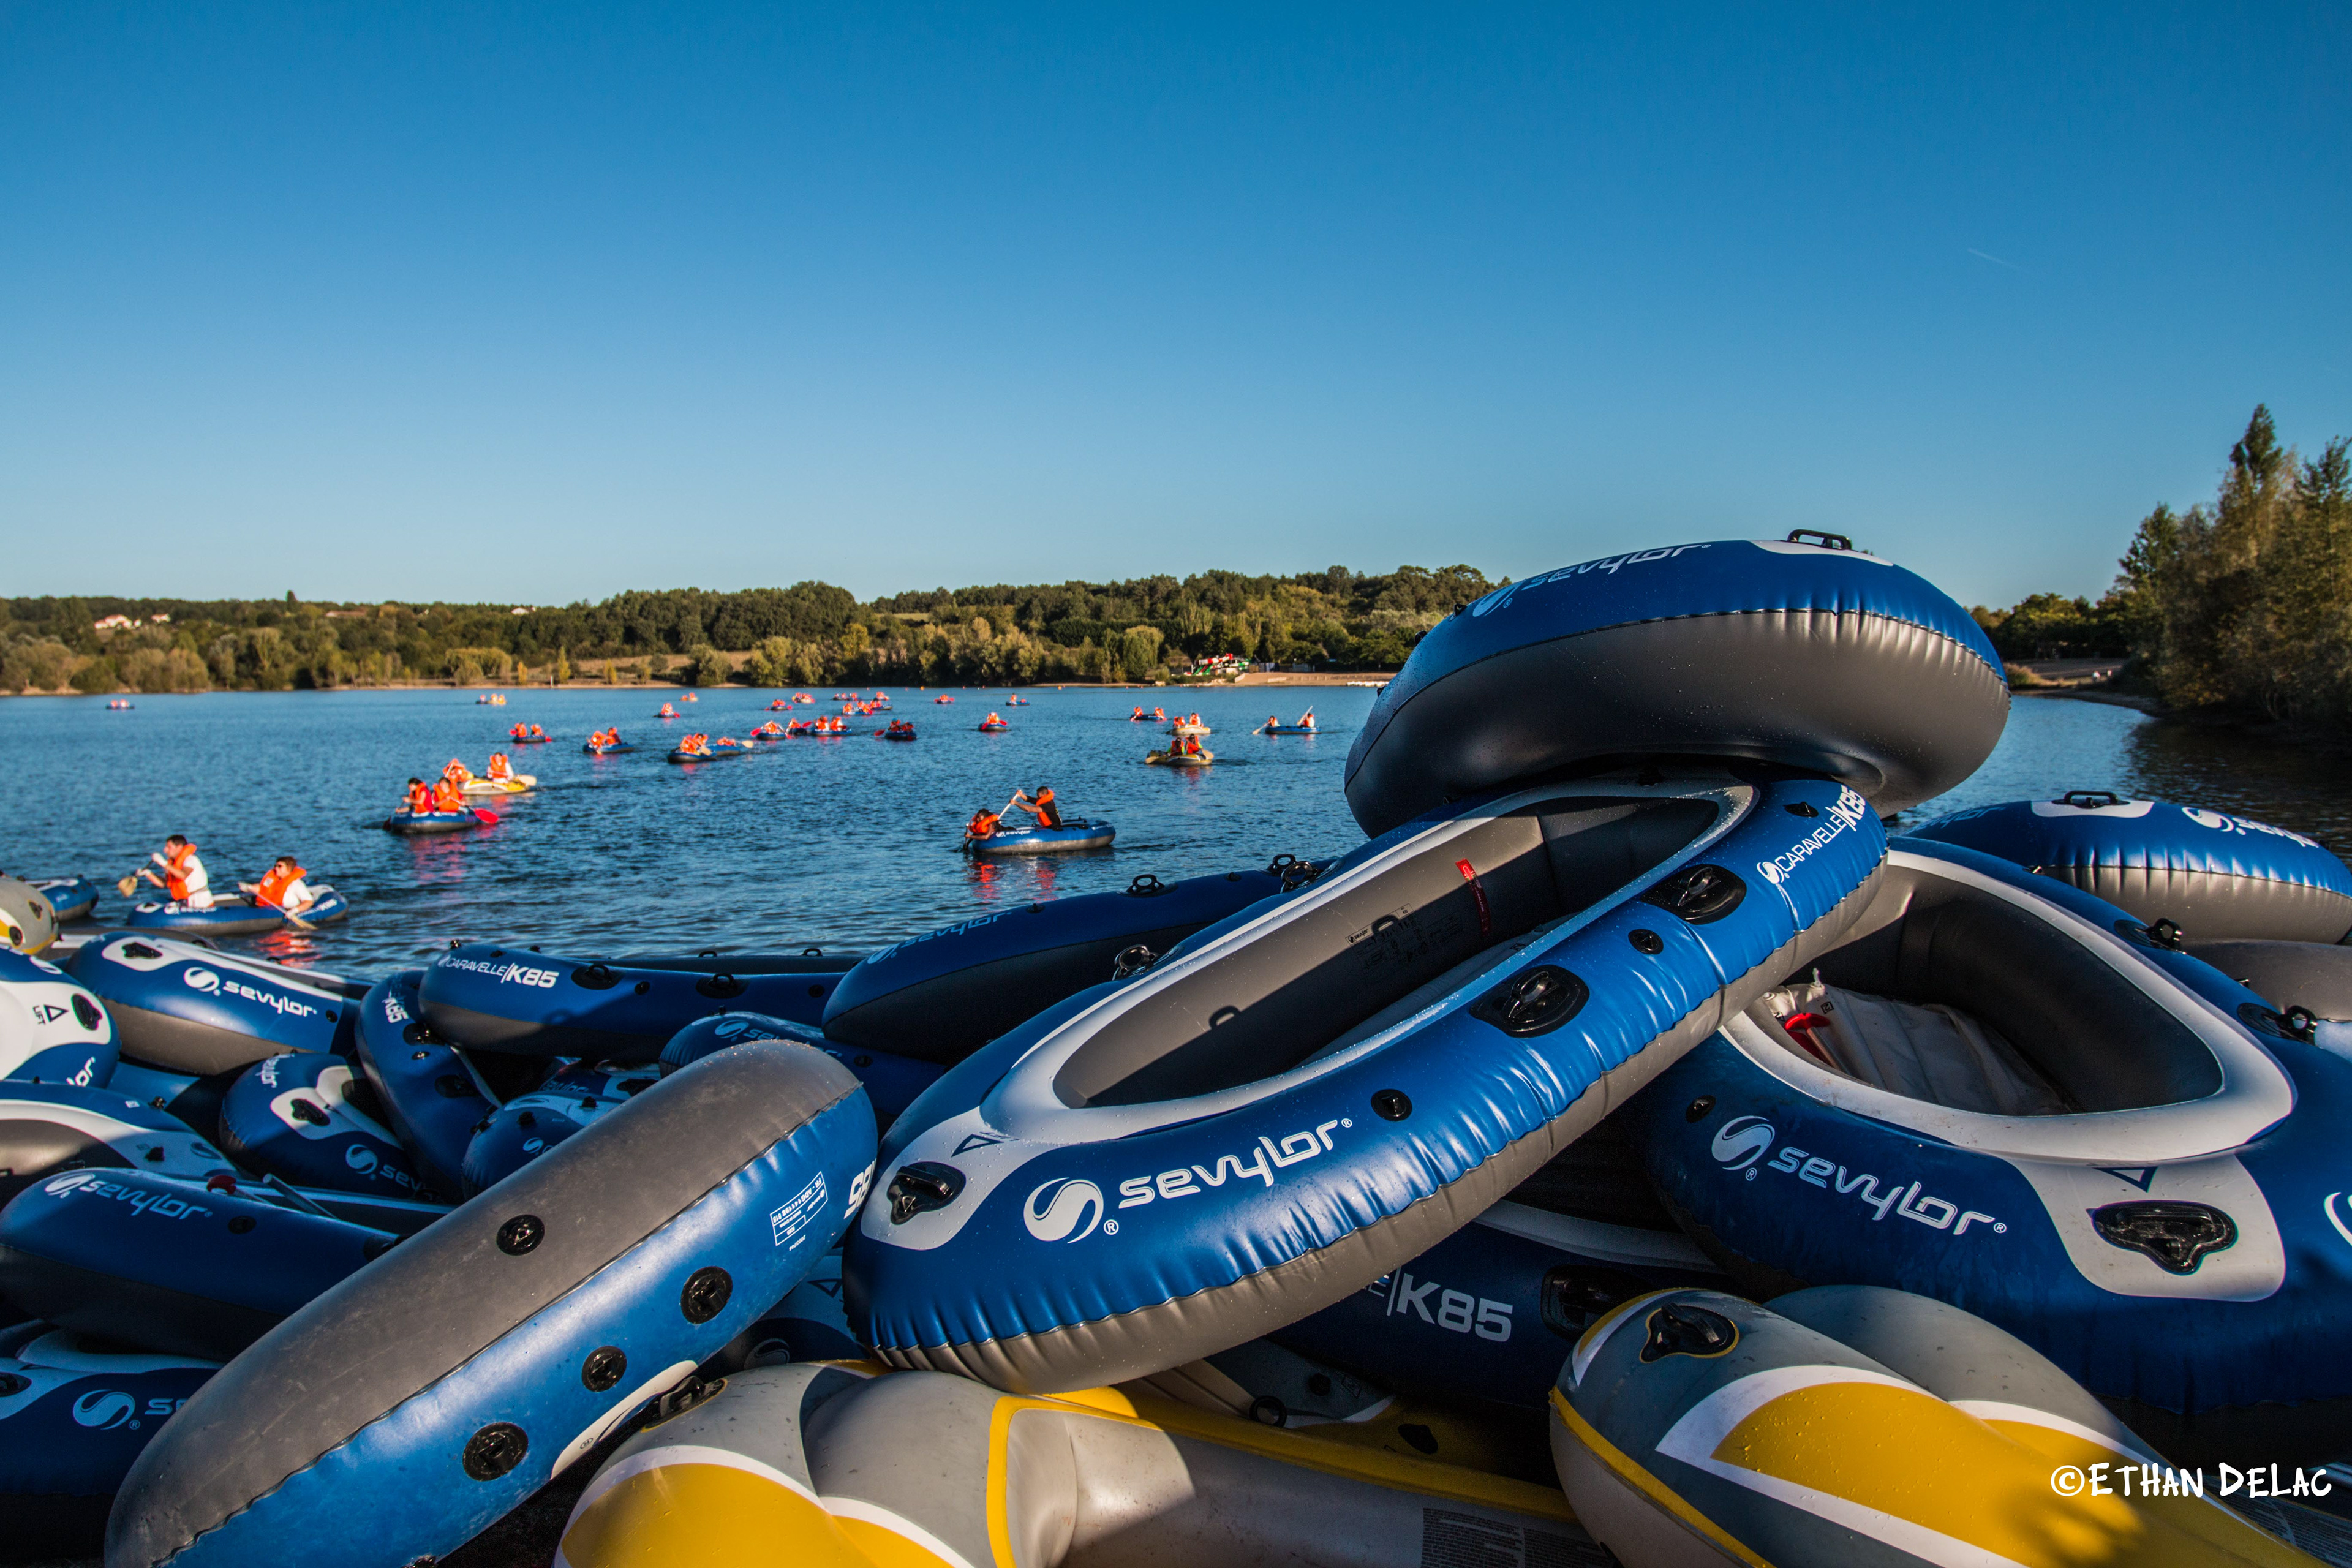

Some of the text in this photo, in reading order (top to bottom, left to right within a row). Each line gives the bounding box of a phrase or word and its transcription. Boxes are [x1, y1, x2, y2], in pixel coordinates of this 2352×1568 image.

[1774, 784, 1866, 872] CARAVELLE K85
[445, 958, 560, 989] CARAVELLE K85
[32, 1005, 46, 1025] LIFT
[1396, 1273, 1513, 1342] K85
